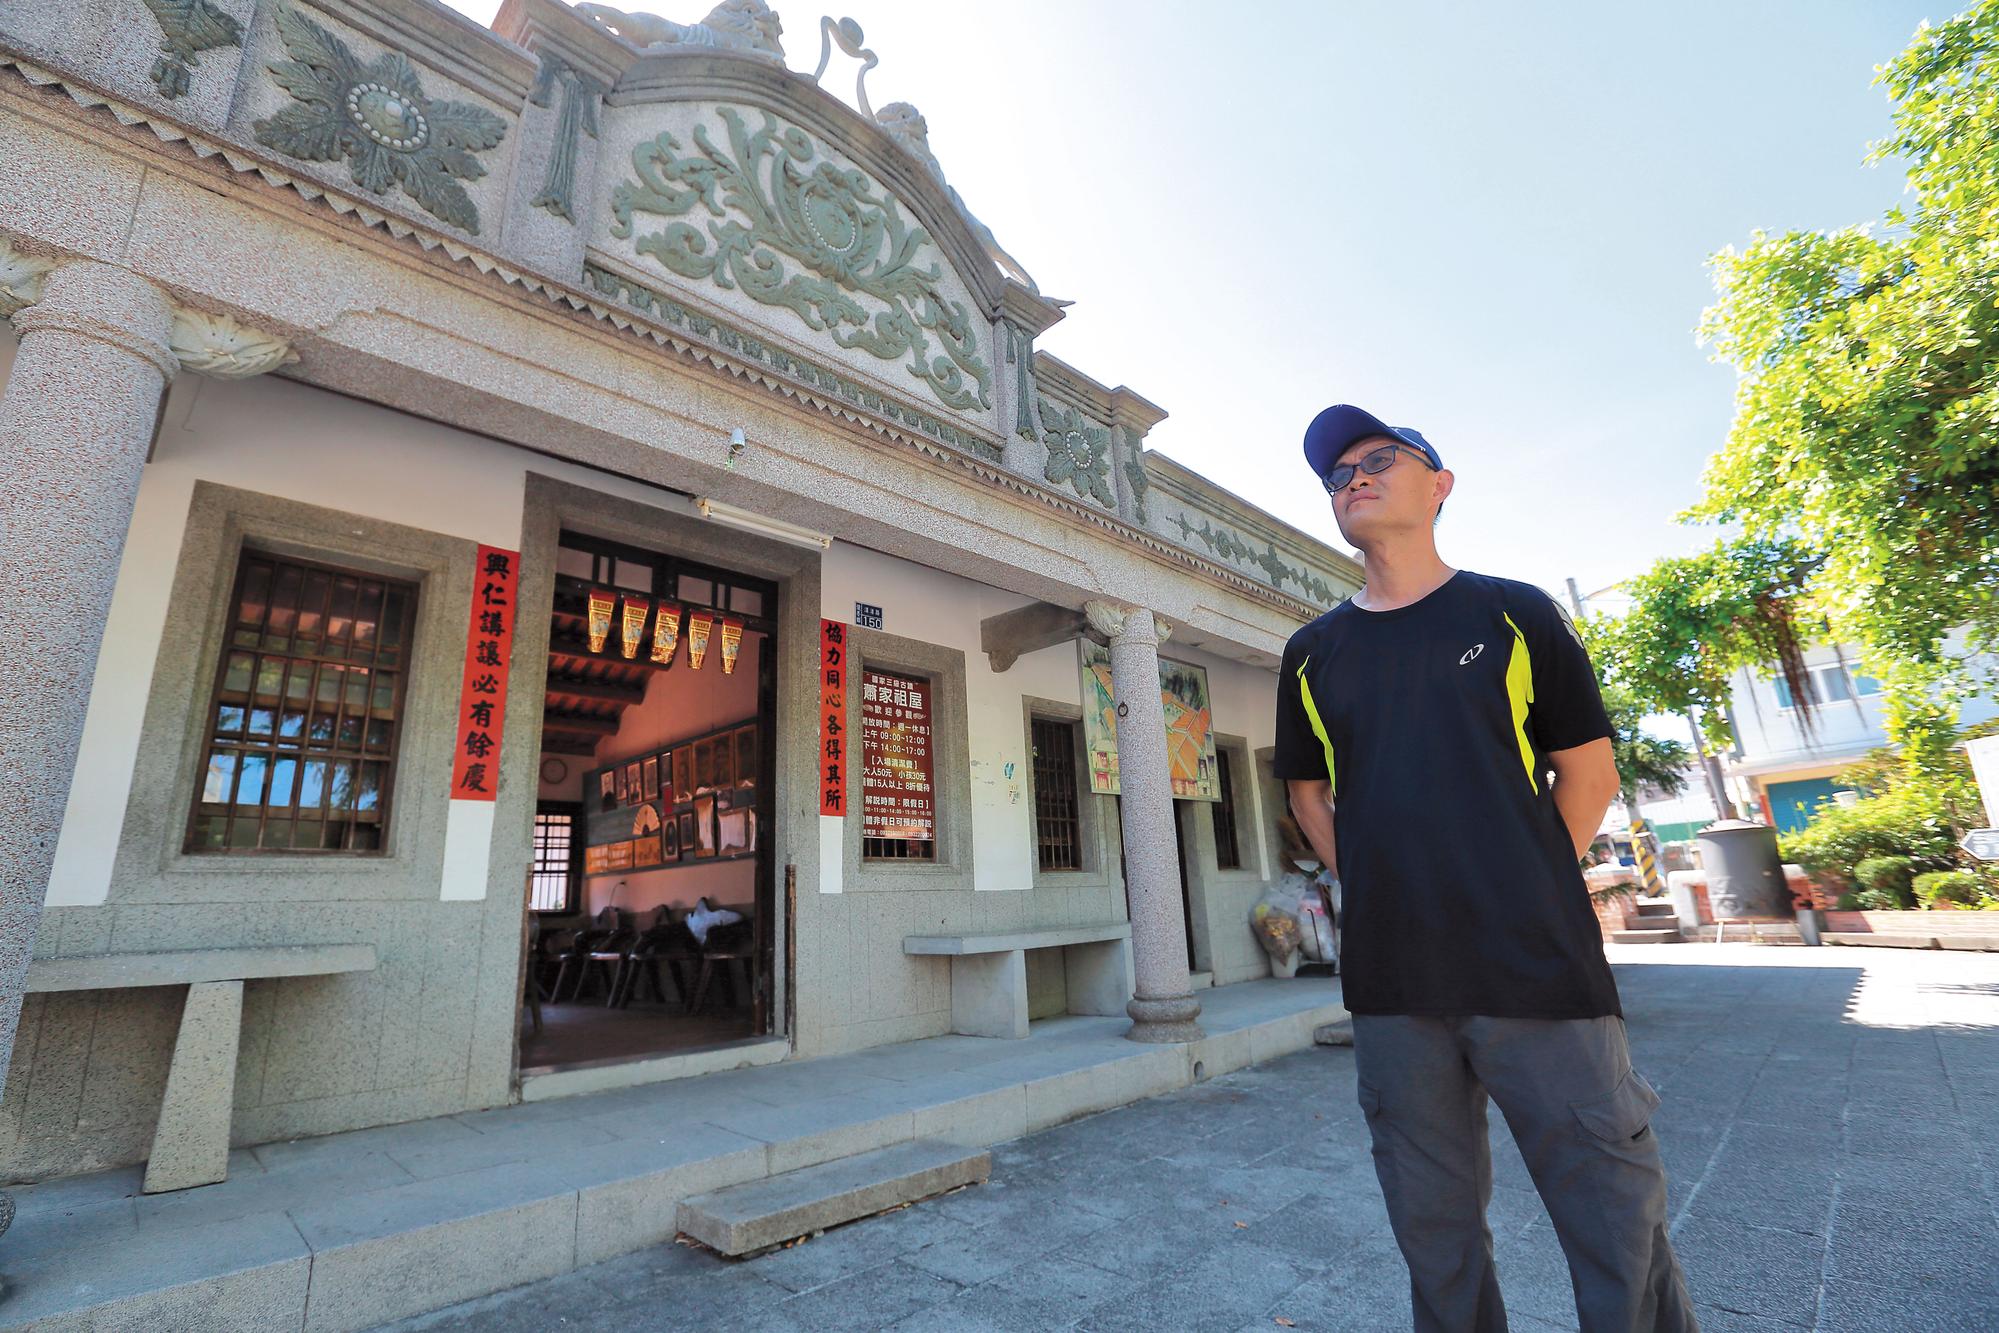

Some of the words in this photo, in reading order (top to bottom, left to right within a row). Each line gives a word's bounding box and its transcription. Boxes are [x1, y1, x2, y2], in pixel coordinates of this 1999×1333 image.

[863, 615, 882, 629] 150
[460, 552, 510, 793] 興仁講讓必有餘慶
[863, 683, 923, 710] 蕭家祖屋
[863, 728, 878, 738] 上午
[863, 740, 878, 750] 下午
[863, 766, 893, 778] 大人50元
[898, 769, 927, 781] 小孩30元
